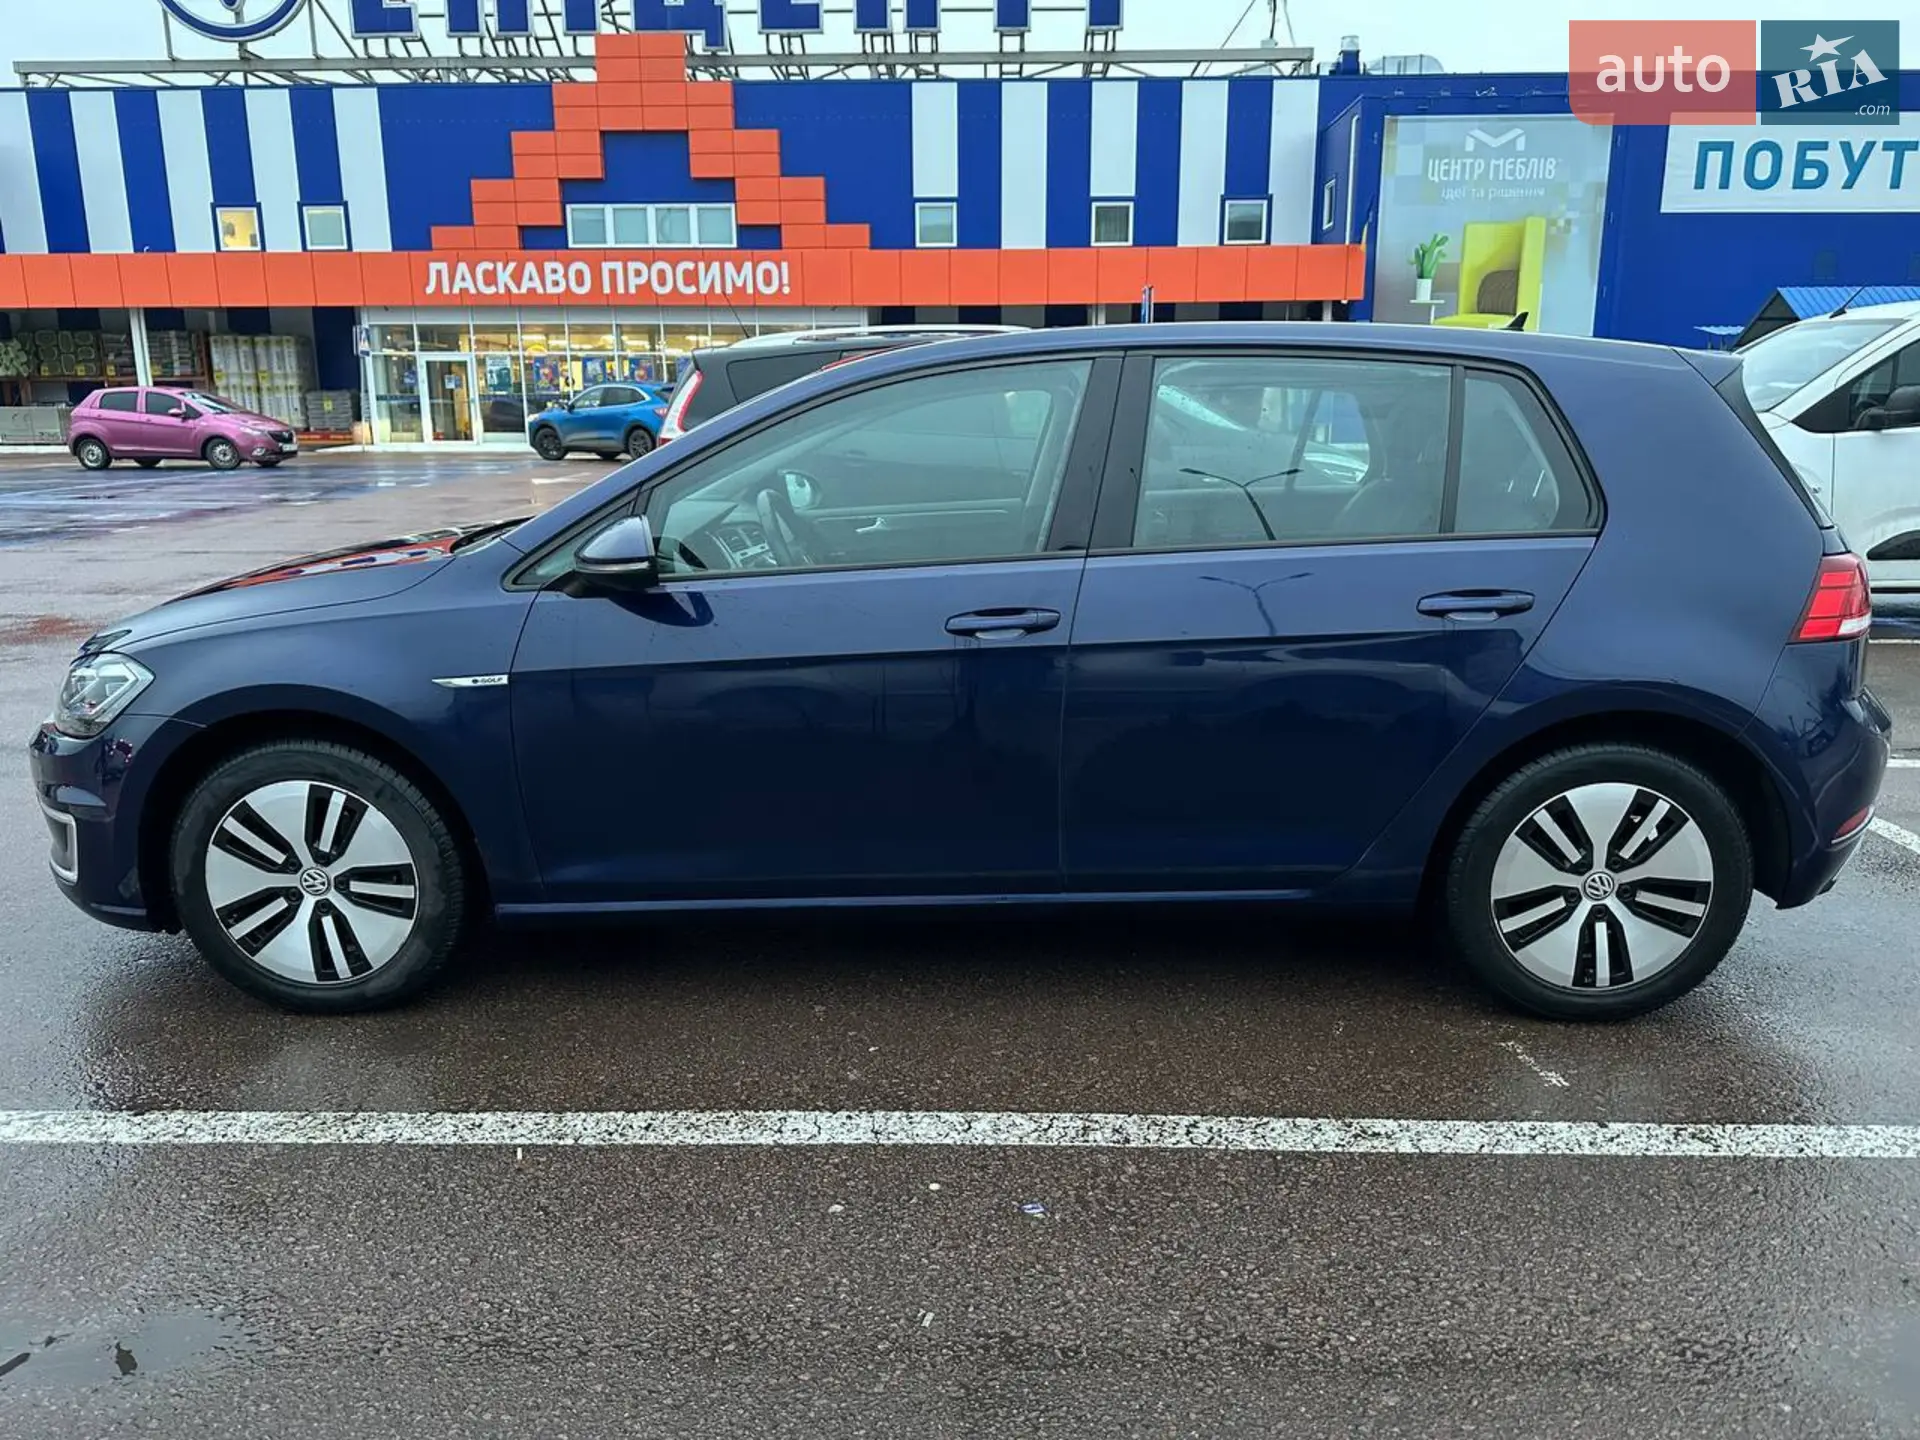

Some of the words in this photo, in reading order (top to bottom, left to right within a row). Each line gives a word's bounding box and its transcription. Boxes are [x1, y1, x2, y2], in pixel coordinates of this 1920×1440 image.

[1428, 158, 1485, 183] ЦЕНТР
[1489, 157, 1557, 181] МЕБЛІВ
[1693, 139, 1919, 190] ПОБУТ
[425, 261, 592, 295] ЛАСКАВО
[601, 260, 791, 295] ПРОСИМО!
